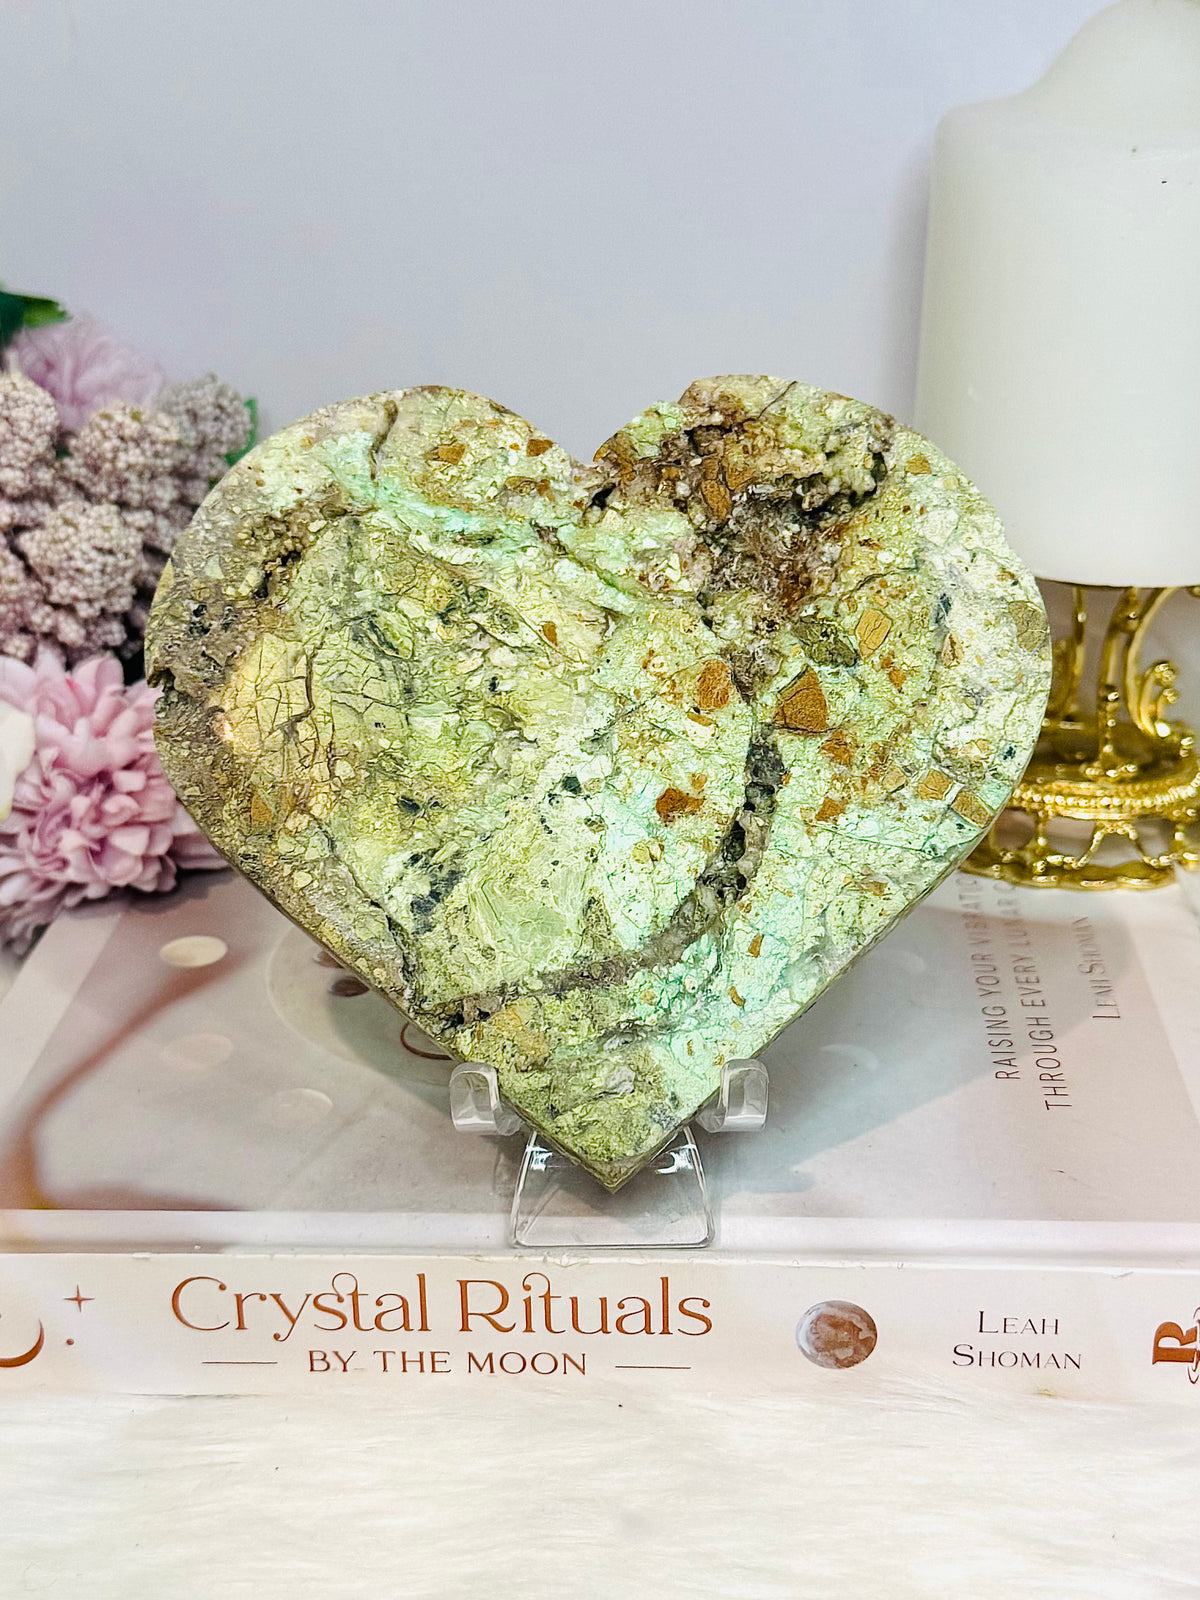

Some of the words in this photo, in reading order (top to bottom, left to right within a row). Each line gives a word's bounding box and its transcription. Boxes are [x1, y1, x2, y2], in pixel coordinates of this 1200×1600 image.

[971, 953, 1002, 997] YOUR
[1012, 953, 1046, 1008] EVERY
[982, 1005, 1021, 1080] RAISING
[1025, 1016, 1073, 1111] THROUGH
[171, 1272, 432, 1342] Crystal
[456, 1272, 713, 1336] Rituals
[308, 1350, 357, 1373] BY
[373, 1350, 452, 1374] THE
[467, 1351, 586, 1376] MOON
